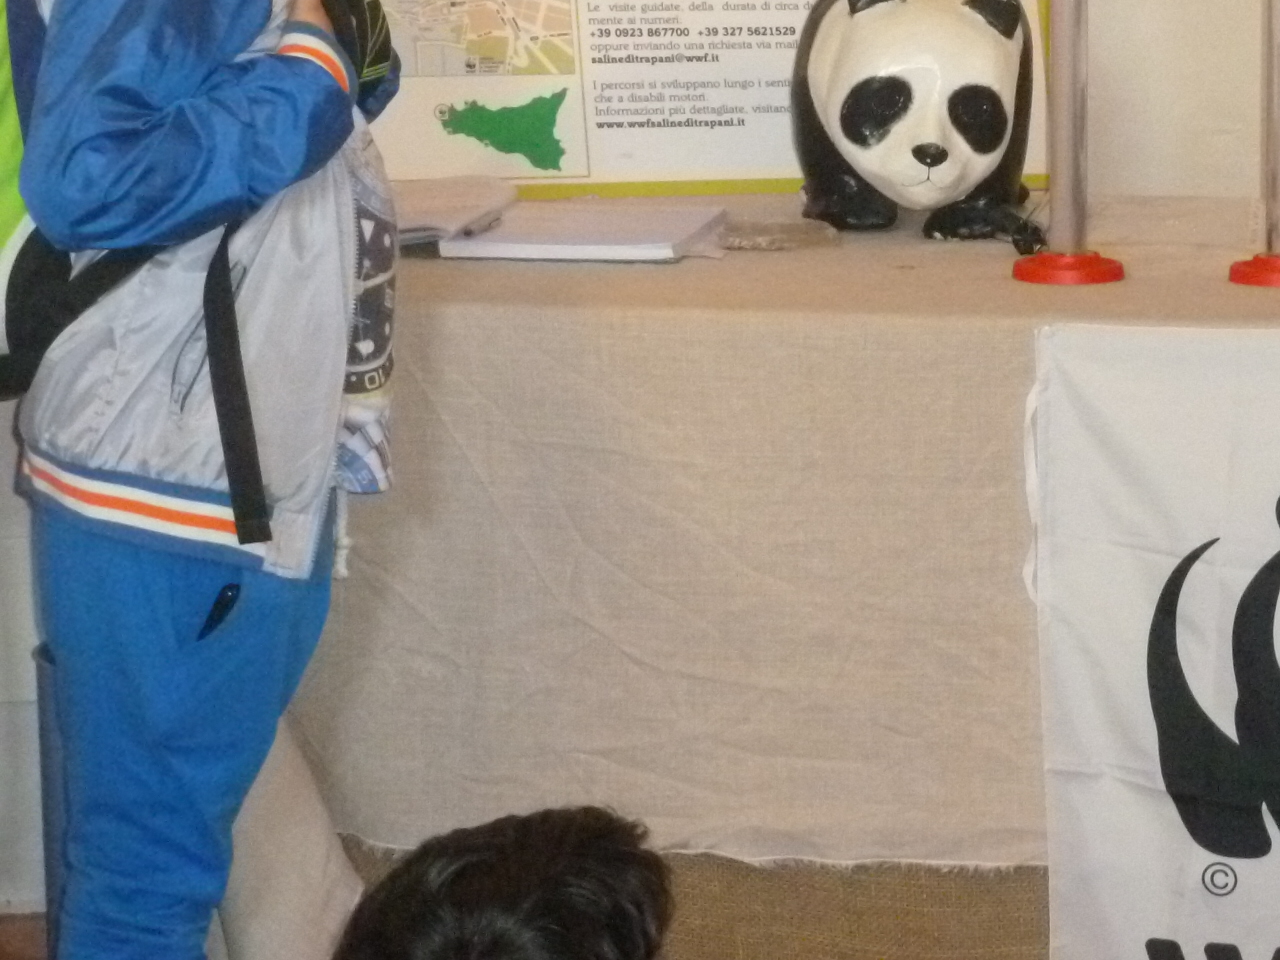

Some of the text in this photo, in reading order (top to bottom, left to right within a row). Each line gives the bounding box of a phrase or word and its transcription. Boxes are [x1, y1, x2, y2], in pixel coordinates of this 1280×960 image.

[591, 26, 796, 38] +39 0923 867700 +39 327 5621529
[590, 43, 630, 54] oppure
[633, 40, 681, 51] inviando
[684, 42, 705, 50] una
[708, 39, 753, 50] richiesta
[756, 39, 773, 50] via
[591, 52, 720, 67] salineditrapani@wwf.it
[594, 93, 614, 104] che
[617, 95, 624, 103] a
[627, 92, 667, 103] disabili
[596, 116, 746, 131] www.wwfsalineditrapani.it
